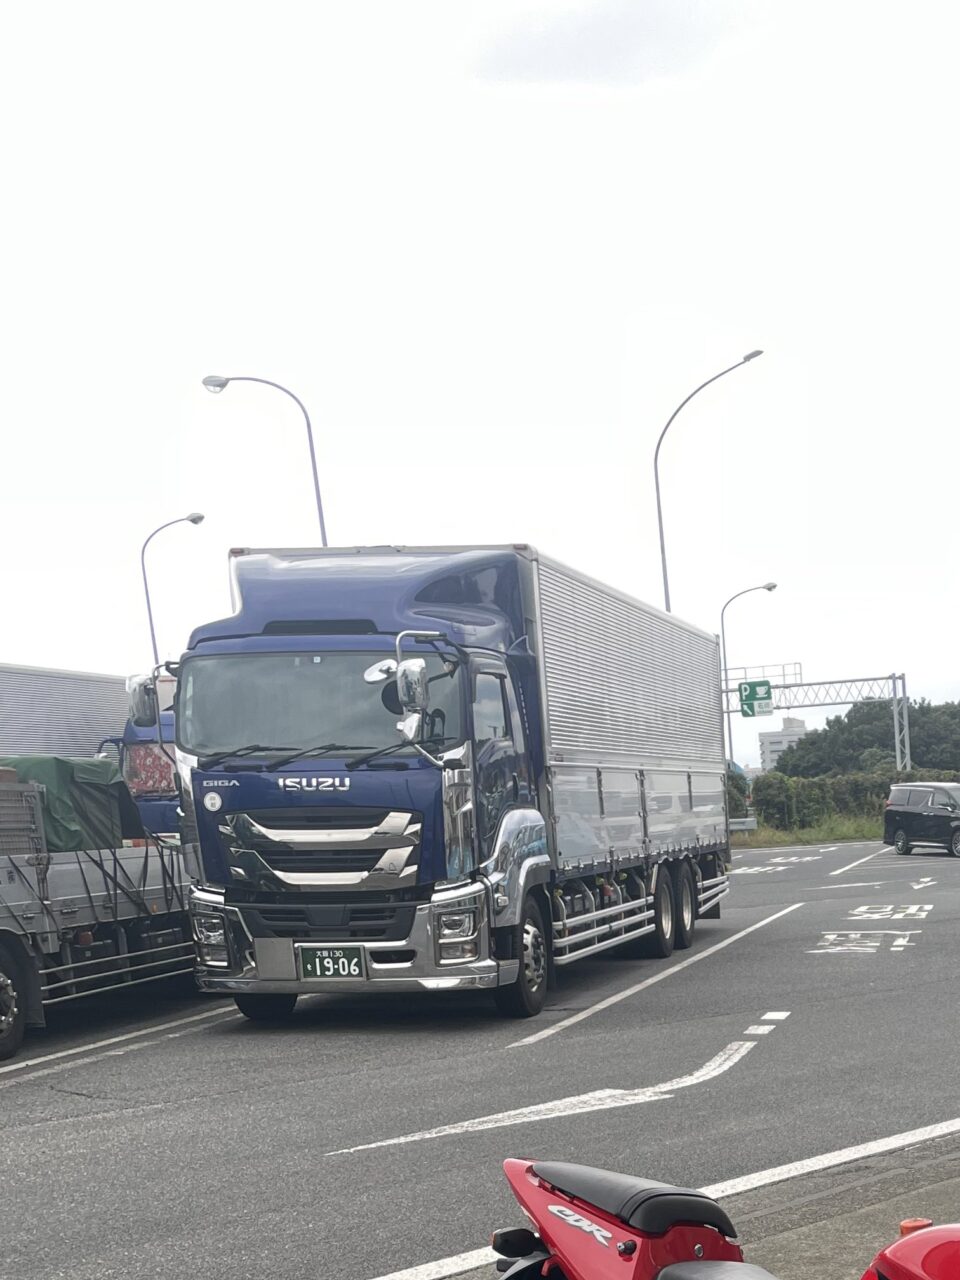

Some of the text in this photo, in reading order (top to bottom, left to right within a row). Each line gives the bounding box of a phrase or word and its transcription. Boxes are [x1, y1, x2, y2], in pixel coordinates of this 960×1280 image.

[741, 684, 750, 700] P
[202, 779, 240, 787] GIGA
[278, 777, 351, 791] ISUZU
[315, 957, 360, 976] 19-06
[547, 1204, 613, 1248] CBR
